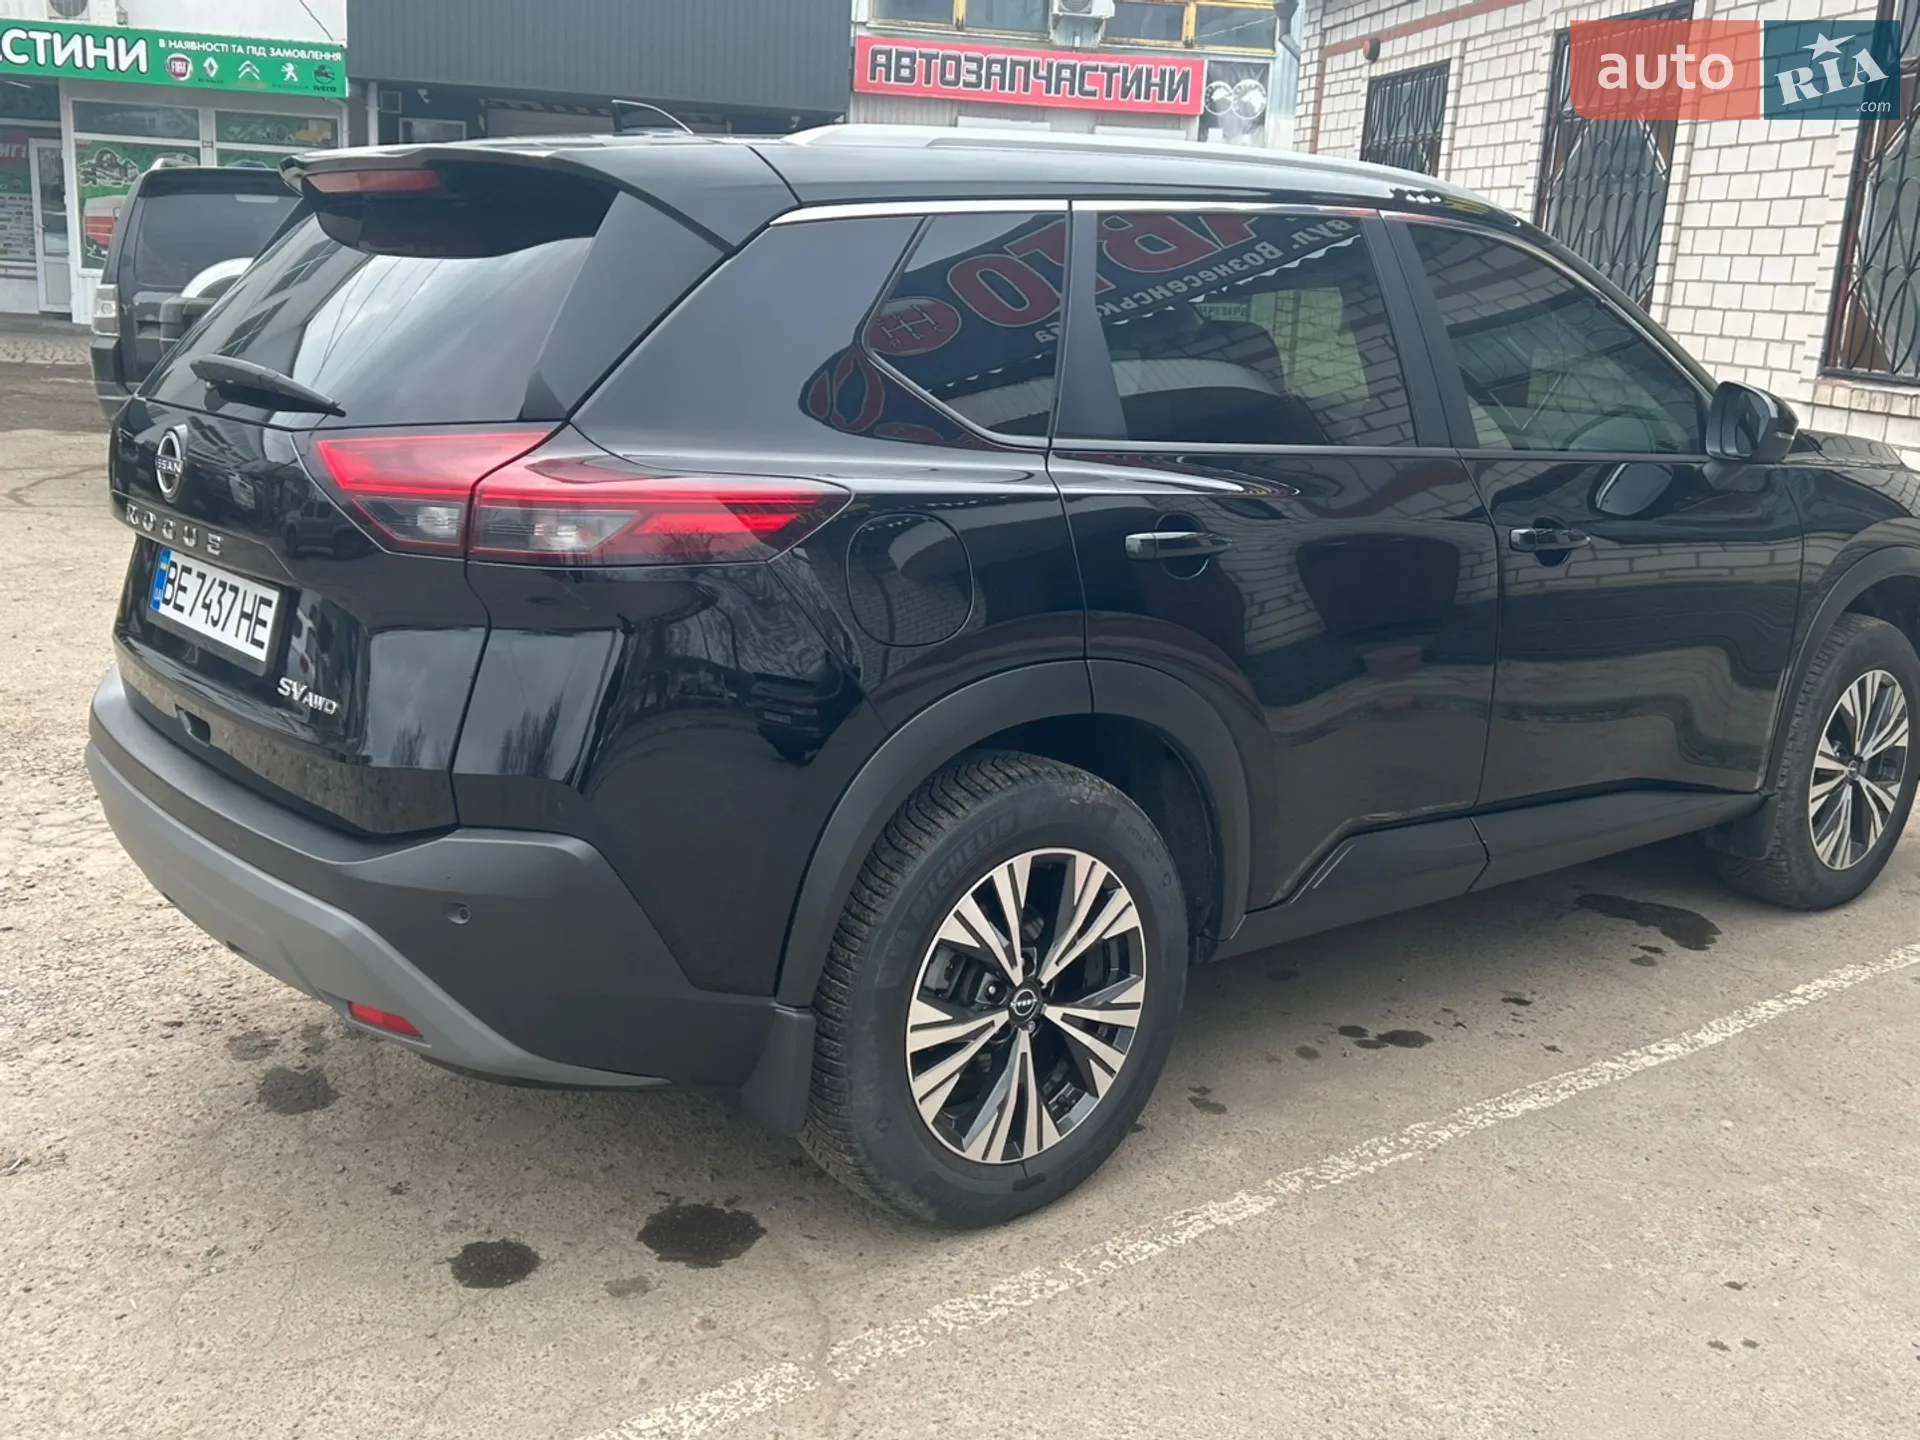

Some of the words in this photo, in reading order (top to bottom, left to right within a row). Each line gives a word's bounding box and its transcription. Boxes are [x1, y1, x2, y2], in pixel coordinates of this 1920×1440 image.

[0, 28, 148, 73] СТИНИ
[158, 38, 166, 48] В
[168, 39, 229, 54] НАЯВНОСТІ
[231, 44, 245, 55] ТА
[246, 45, 268, 58] ПІД
[268, 47, 342, 61] ЗАМОВЛЕННЯ
[313, 85, 337, 93] IVECO
[869, 45, 1192, 104] АВТОЗАПЧАСТИНИ
[125, 503, 224, 556] ROGUE
